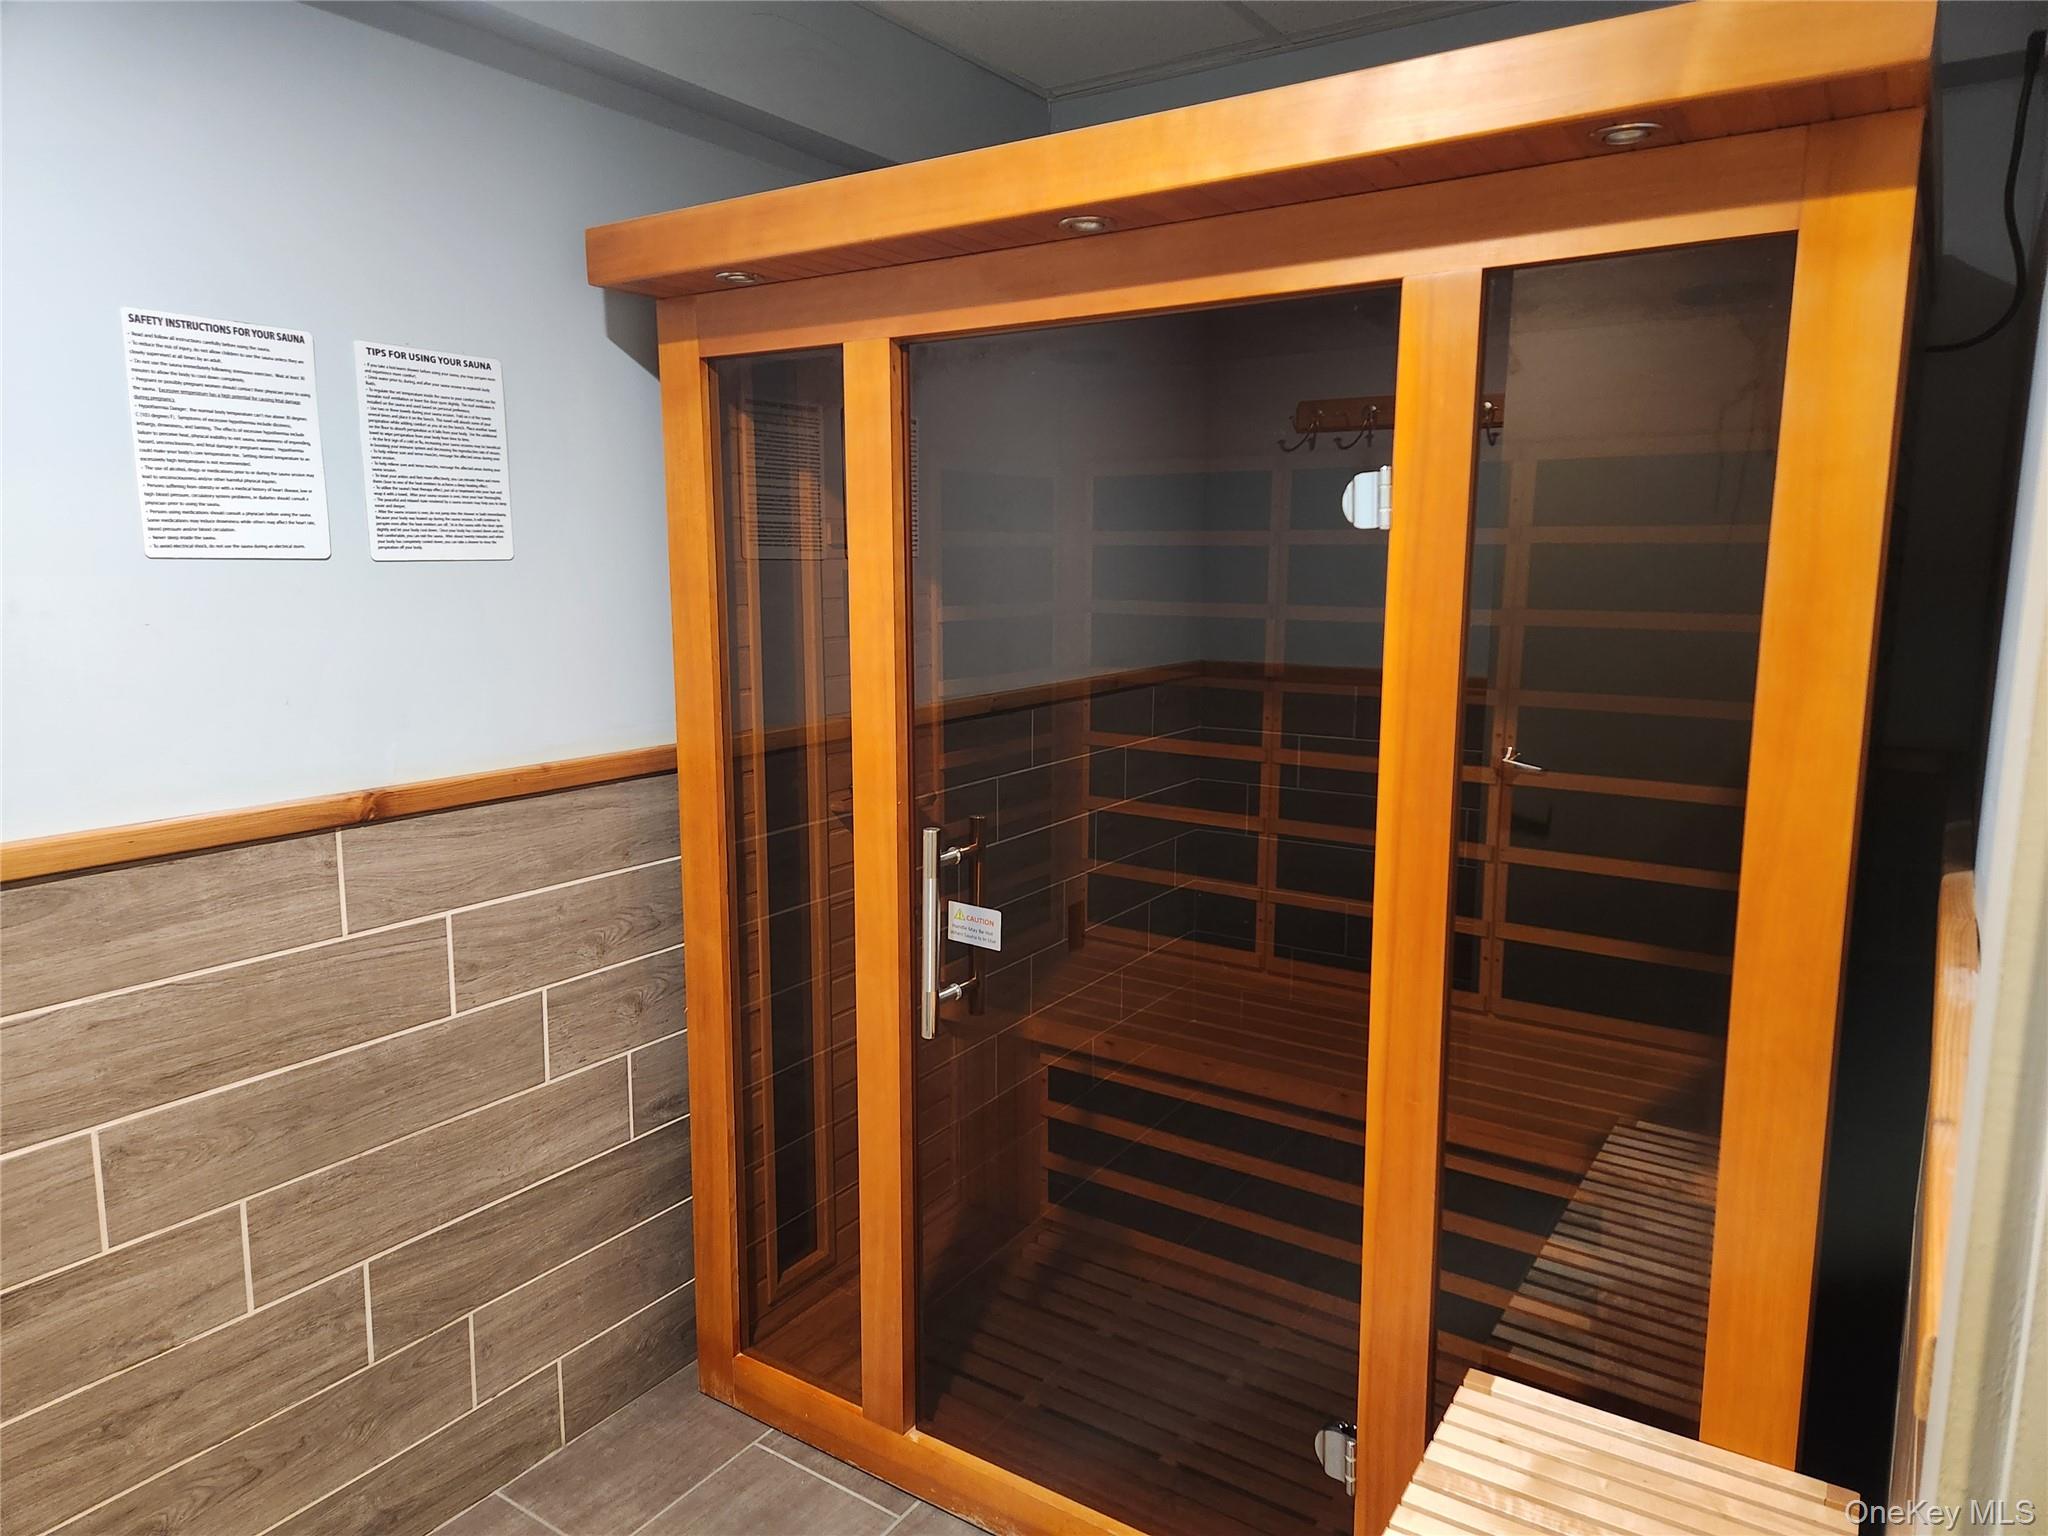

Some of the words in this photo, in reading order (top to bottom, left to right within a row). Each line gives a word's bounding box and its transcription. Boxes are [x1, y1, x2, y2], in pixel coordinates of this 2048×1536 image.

[128, 313, 162, 326] SAFETY
[165, 318, 231, 334] INSTRUCTIONS
[232, 326, 250, 337] FOR
[251, 329, 275, 340] YOUR
[276, 332, 304, 344] SAUNA
[366, 346, 386, 357] TIPS
[388, 350, 406, 359] FOR
[408, 352, 436, 363] USING
[437, 356, 461, 366] YOUR
[463, 360, 491, 370] SAUNA
[966, 914, 994, 927] CAUTION
